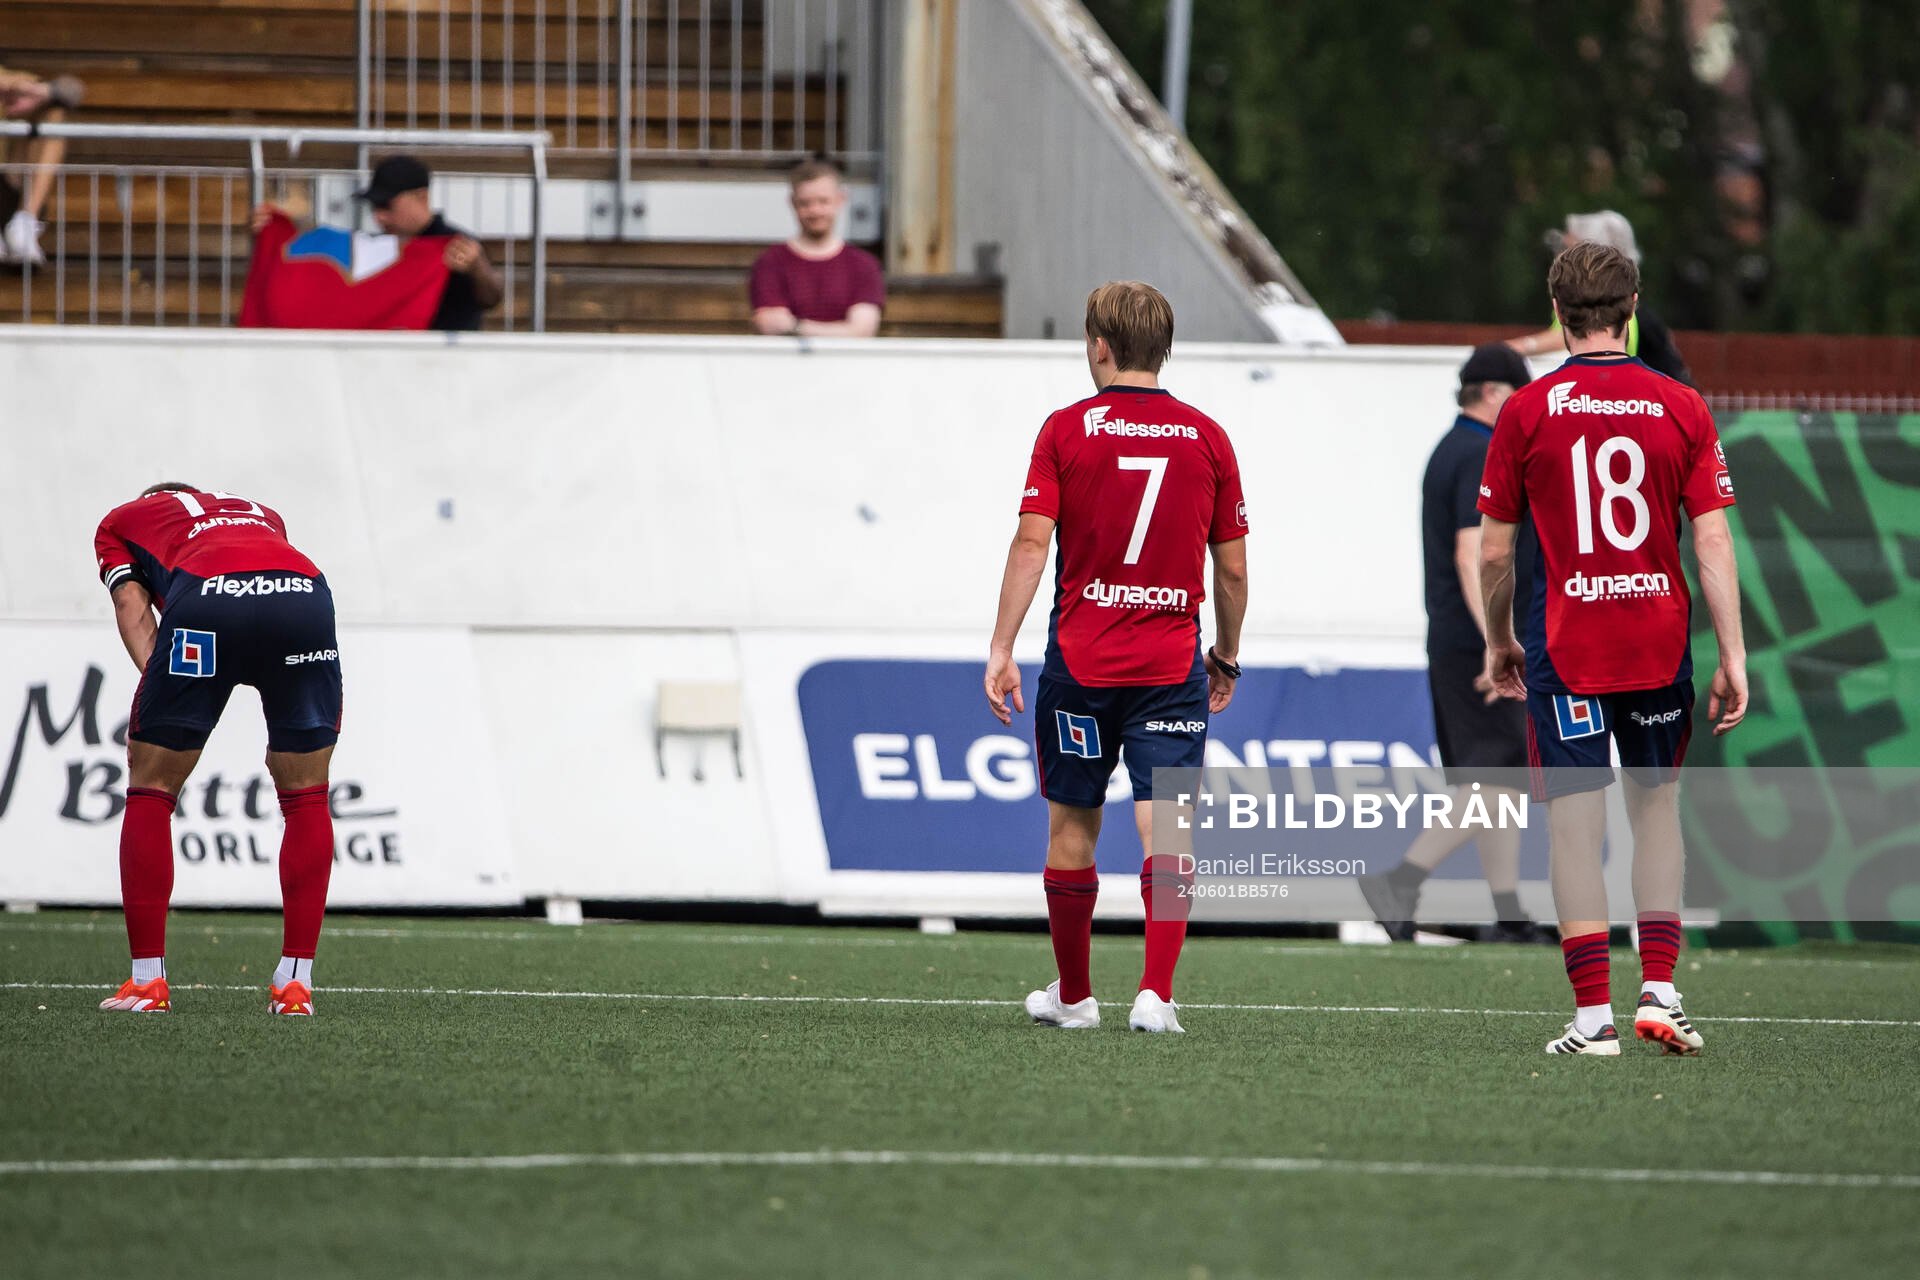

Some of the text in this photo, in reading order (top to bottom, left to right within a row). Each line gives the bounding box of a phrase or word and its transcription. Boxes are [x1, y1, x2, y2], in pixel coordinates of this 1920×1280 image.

[1555, 394, 1664, 417] Fellessons
[1091, 416, 1199, 440] Fellessons
[1571, 435, 1651, 554] 18
[1118, 456, 1169, 565] 7
[200, 574, 314, 598] Flexbuss
[1083, 578, 1188, 608] dynacon
[1565, 571, 1670, 602] dynacon
[285, 648, 338, 665] SHARP
[1144, 720, 1206, 733] SHARP
[1630, 708, 1682, 726] SHARP
[852, 732, 1462, 804] ELGNTEN
[178, 832, 402, 864] ORLGE
